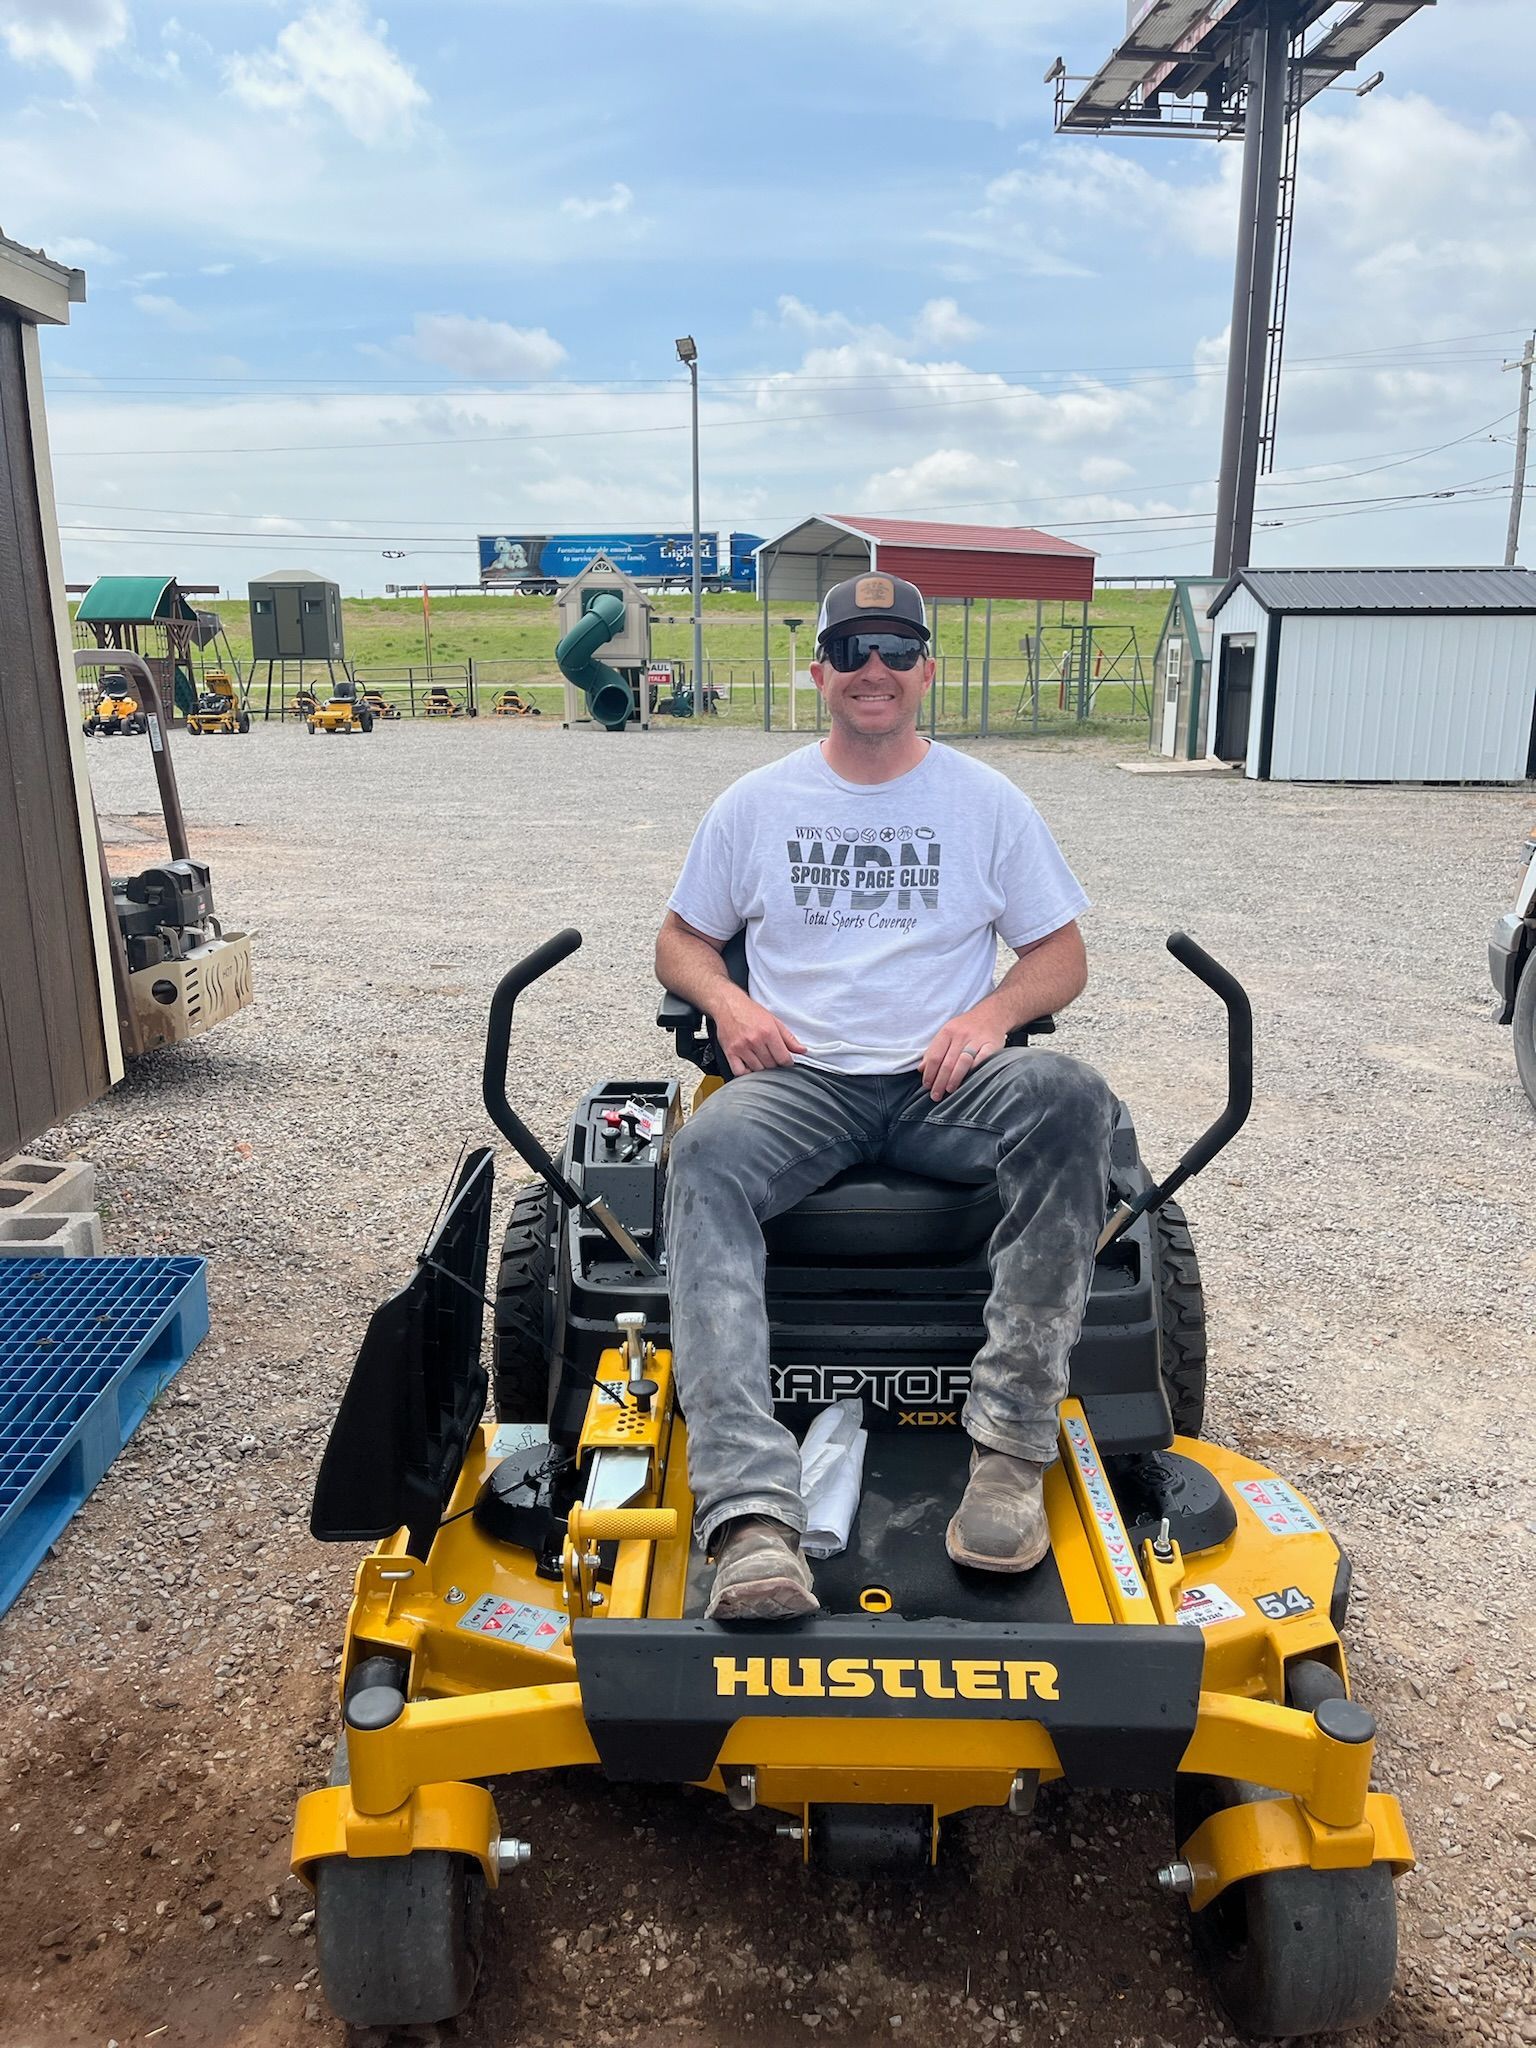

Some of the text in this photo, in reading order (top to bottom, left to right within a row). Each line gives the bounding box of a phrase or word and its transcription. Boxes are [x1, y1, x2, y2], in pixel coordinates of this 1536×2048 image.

[660, 544, 710, 561] Englad
[796, 826, 823, 840] WDN
[791, 866, 939, 889] SPORTS PAGE CLUB
[803, 908, 917, 935] Total Sports Coverage
[898, 1411, 958, 1426] XDX
[1256, 1588, 1311, 1619] 54
[713, 1656, 1061, 1701] HUSTLER
